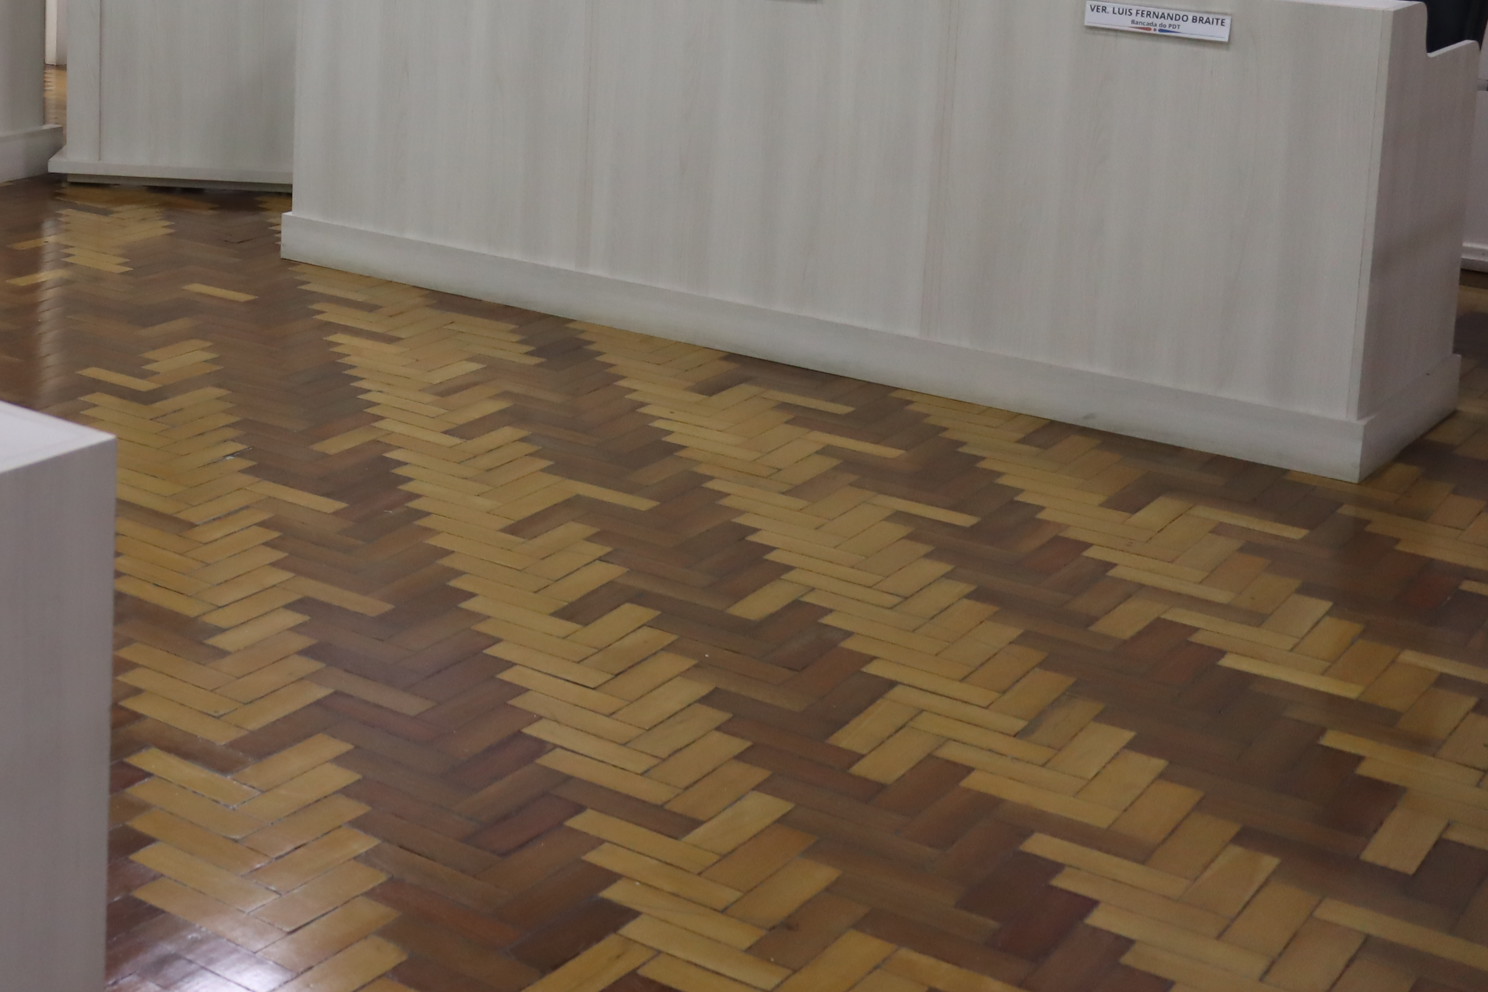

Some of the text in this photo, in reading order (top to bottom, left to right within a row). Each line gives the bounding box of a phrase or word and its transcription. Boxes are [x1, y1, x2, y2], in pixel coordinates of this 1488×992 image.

[1089, 4, 1226, 27] VER. LUIS FERNANDO BRAITE
[1130, 19, 1158, 28] Bancada
